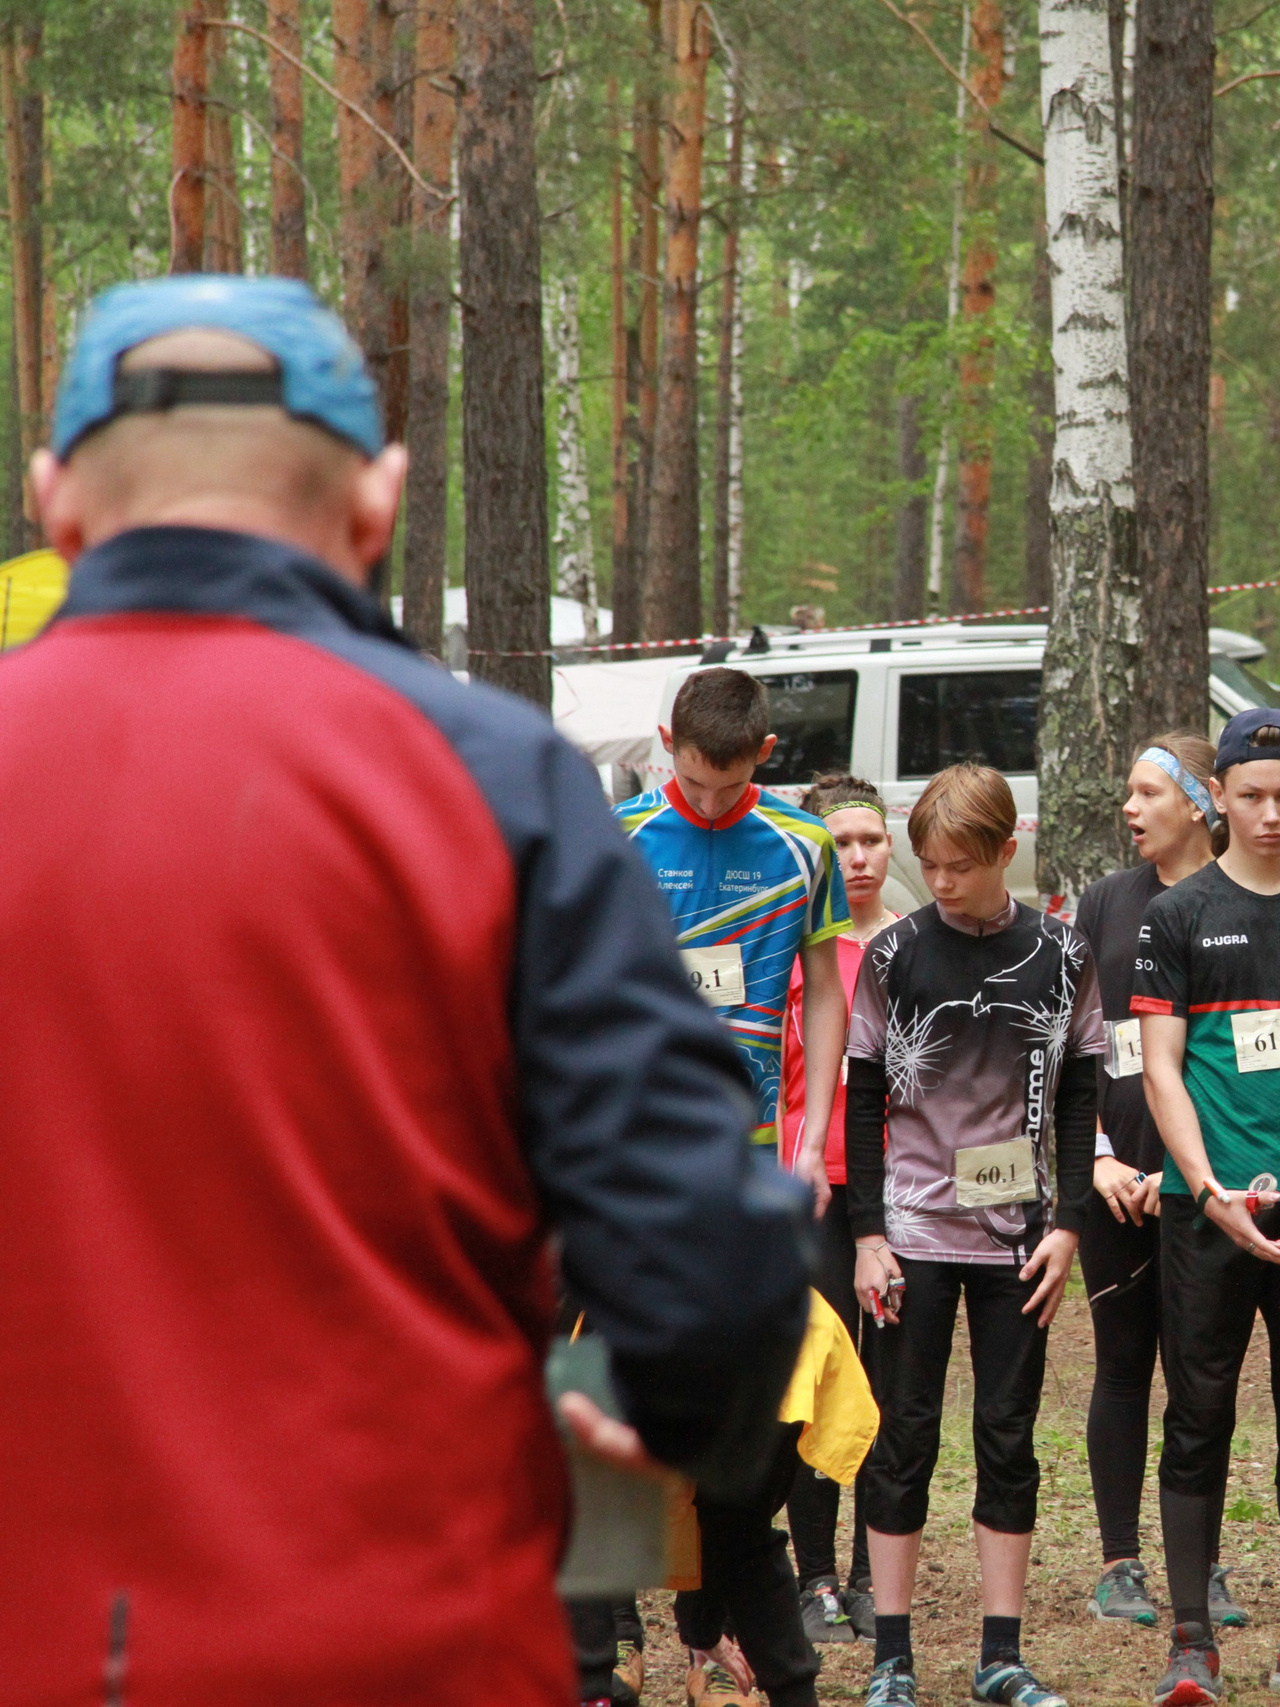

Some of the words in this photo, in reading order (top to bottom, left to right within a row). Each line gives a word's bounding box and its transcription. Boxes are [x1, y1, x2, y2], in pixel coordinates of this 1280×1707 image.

[657, 868, 694, 878] Станков
[725, 869, 750, 881] ДЮСШ
[752, 871, 762, 880] 19
[657, 880, 694, 890] Алексей
[1202, 934, 1249, 948] O-UGRA
[1134, 957, 1158, 972] SO
[690, 968, 722, 991] 9.1
[1025, 1049, 1045, 1152] name
[975, 1163, 1017, 1186] 60.1
